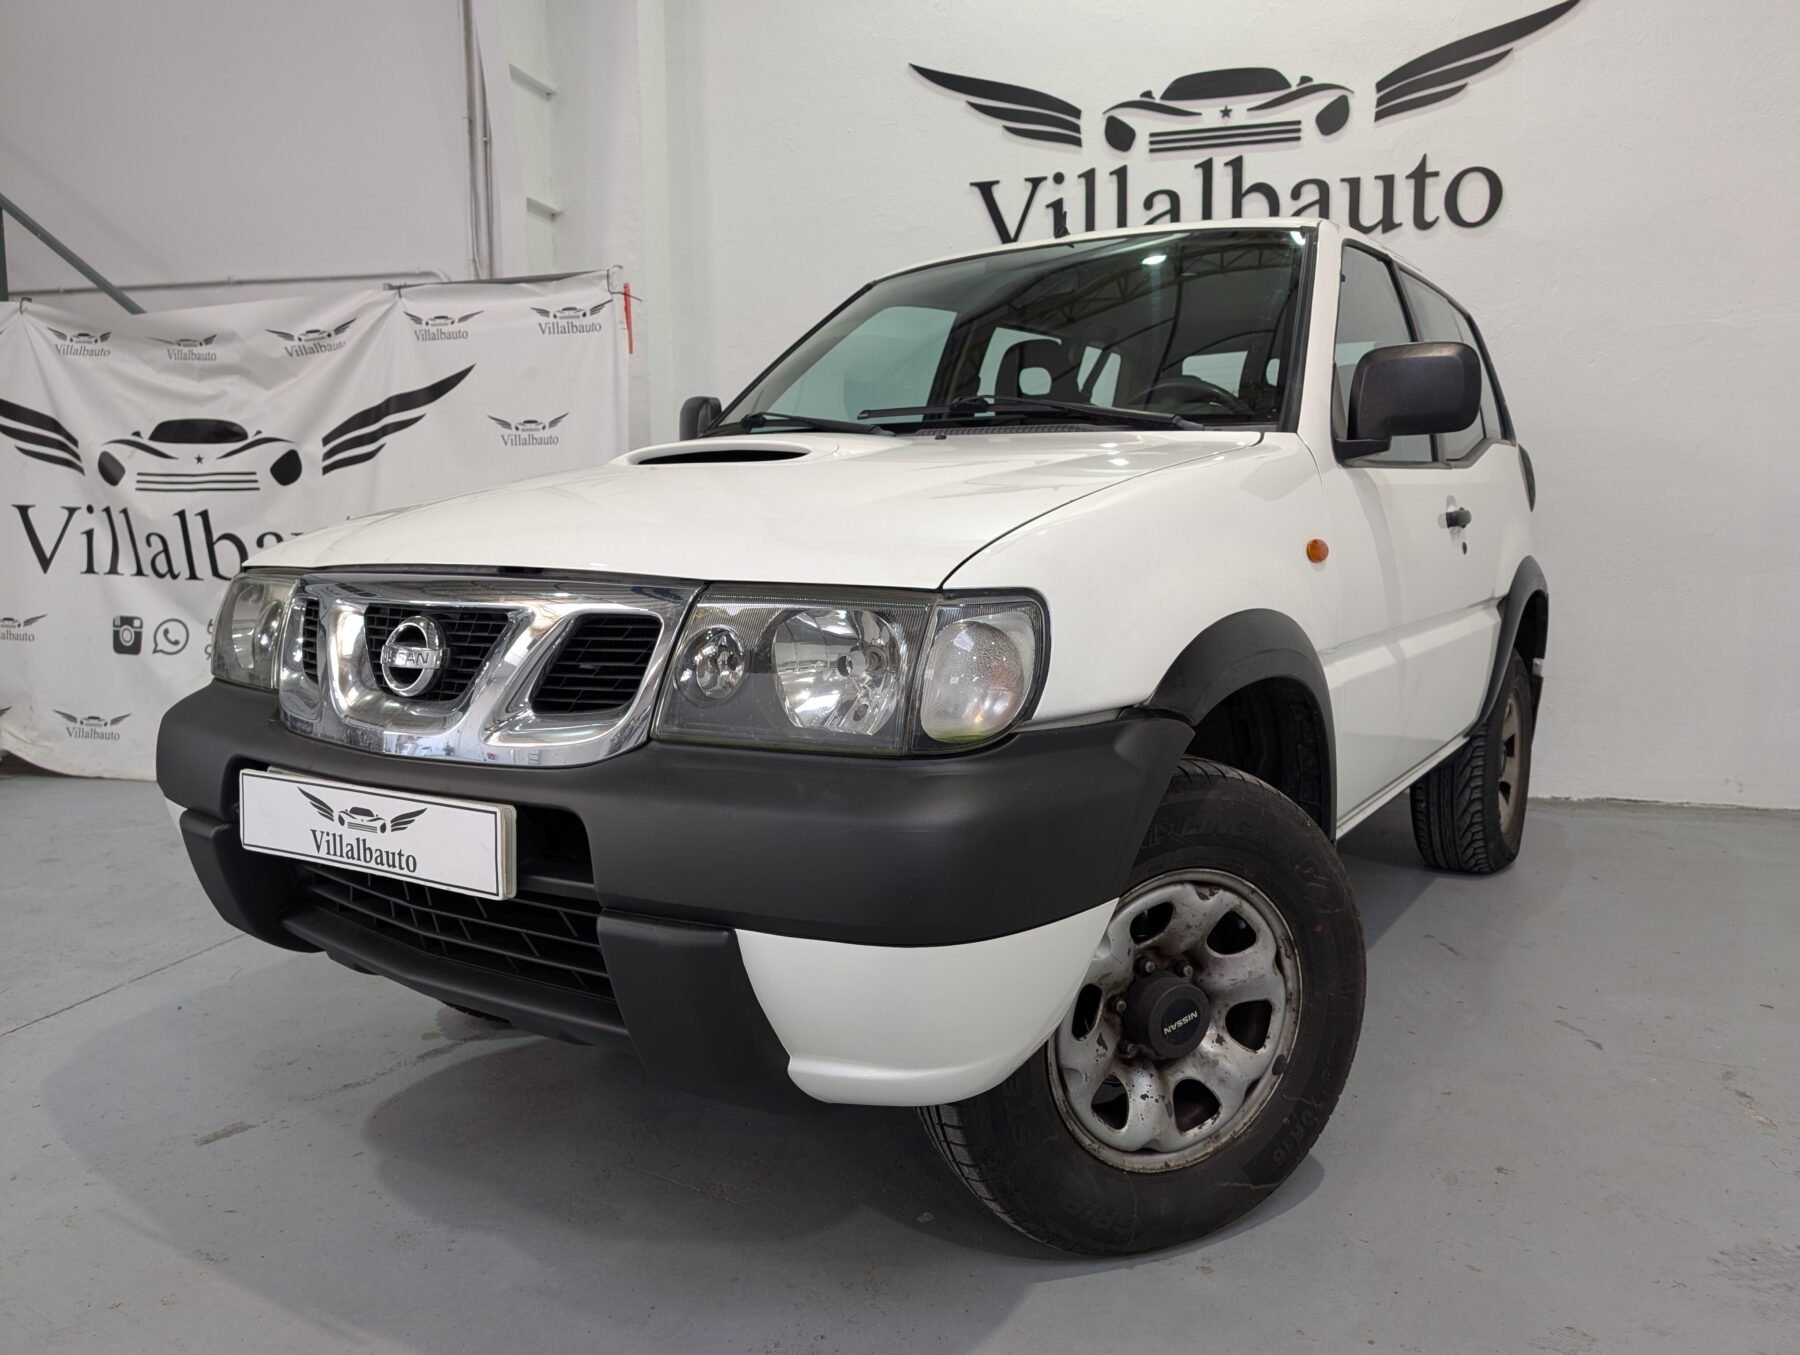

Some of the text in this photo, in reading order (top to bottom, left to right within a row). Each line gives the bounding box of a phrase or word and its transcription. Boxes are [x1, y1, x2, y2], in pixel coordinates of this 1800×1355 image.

[414, 327, 469, 342] Villalbauto
[538, 321, 602, 335] Villalbauto
[54, 343, 111, 357] Villalbauto
[166, 348, 217, 362] Villalbauto
[501, 433, 559, 446] Villalbauto
[11, 504, 304, 582] Villalb
[0, 630, 35, 642] albauto
[66, 726, 120, 741] Villalbauto
[310, 829, 417, 873] Villalbauto
[1163, 1010, 1198, 1035] NISSAN
